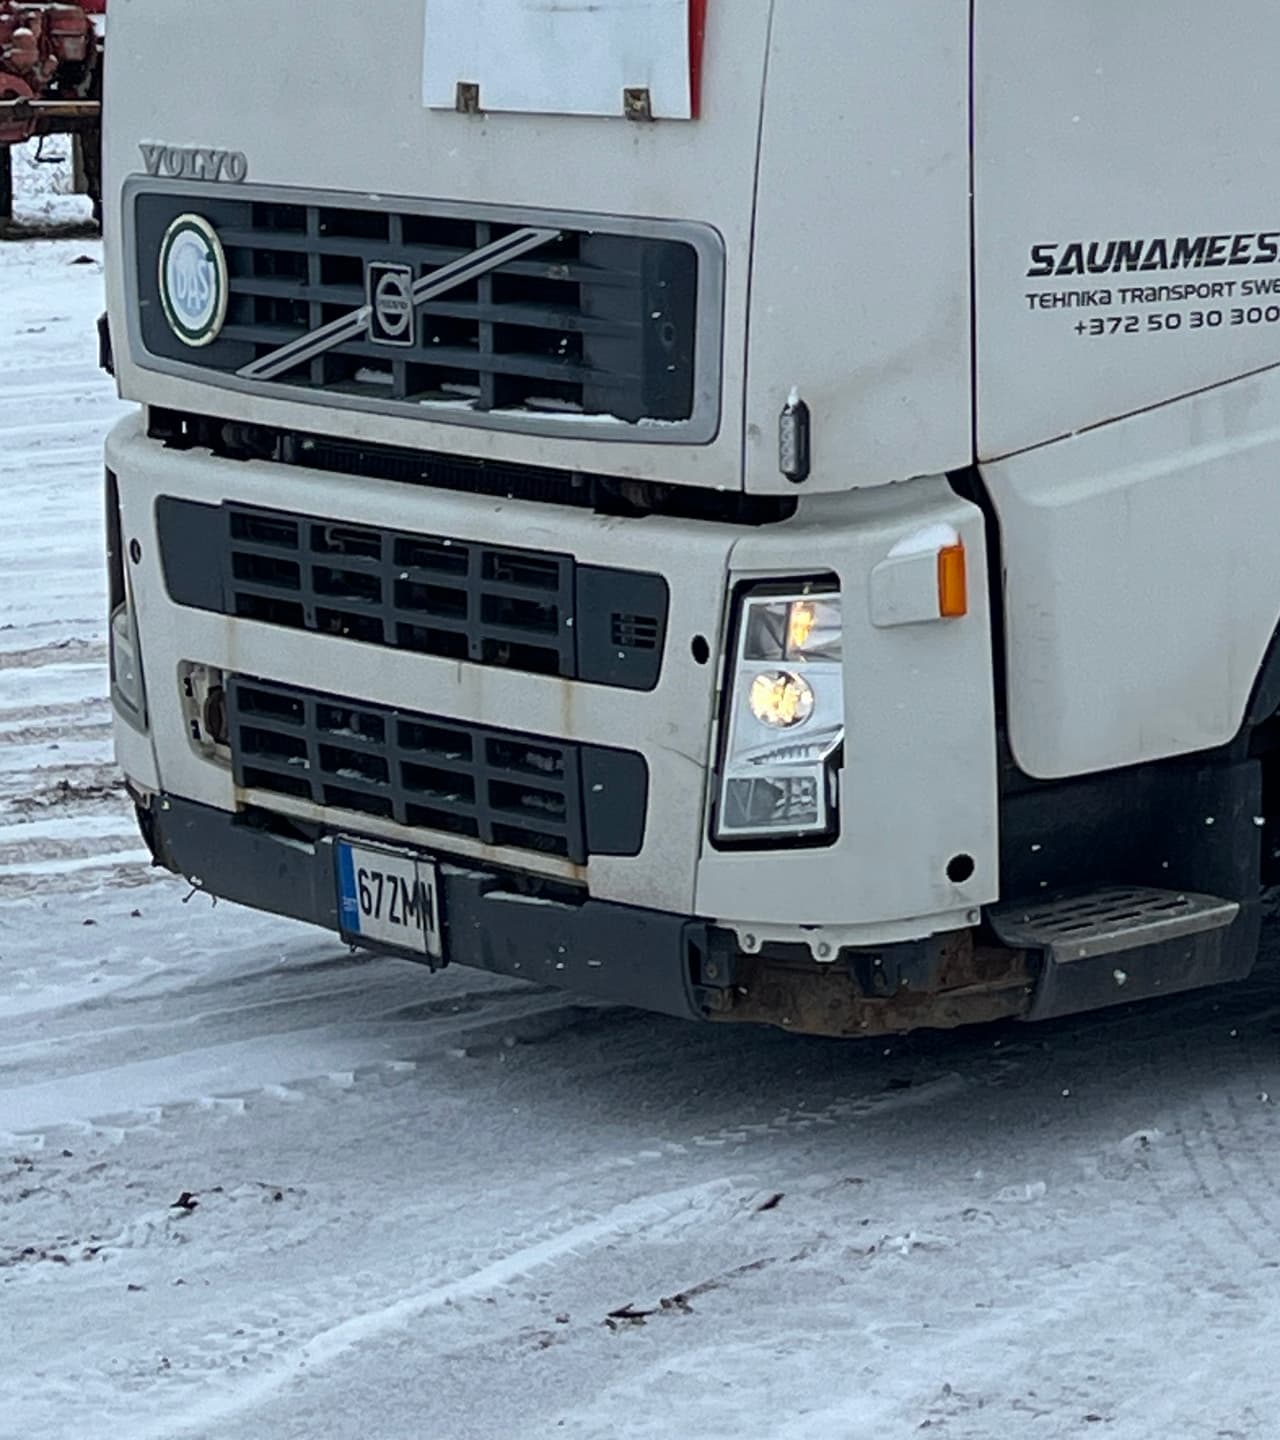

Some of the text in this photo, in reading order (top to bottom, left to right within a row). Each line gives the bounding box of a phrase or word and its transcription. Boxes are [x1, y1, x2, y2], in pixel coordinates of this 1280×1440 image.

[138, 142, 248, 183] VOLVO
[1074, 305, 1280, 336] +372 50 30 300
